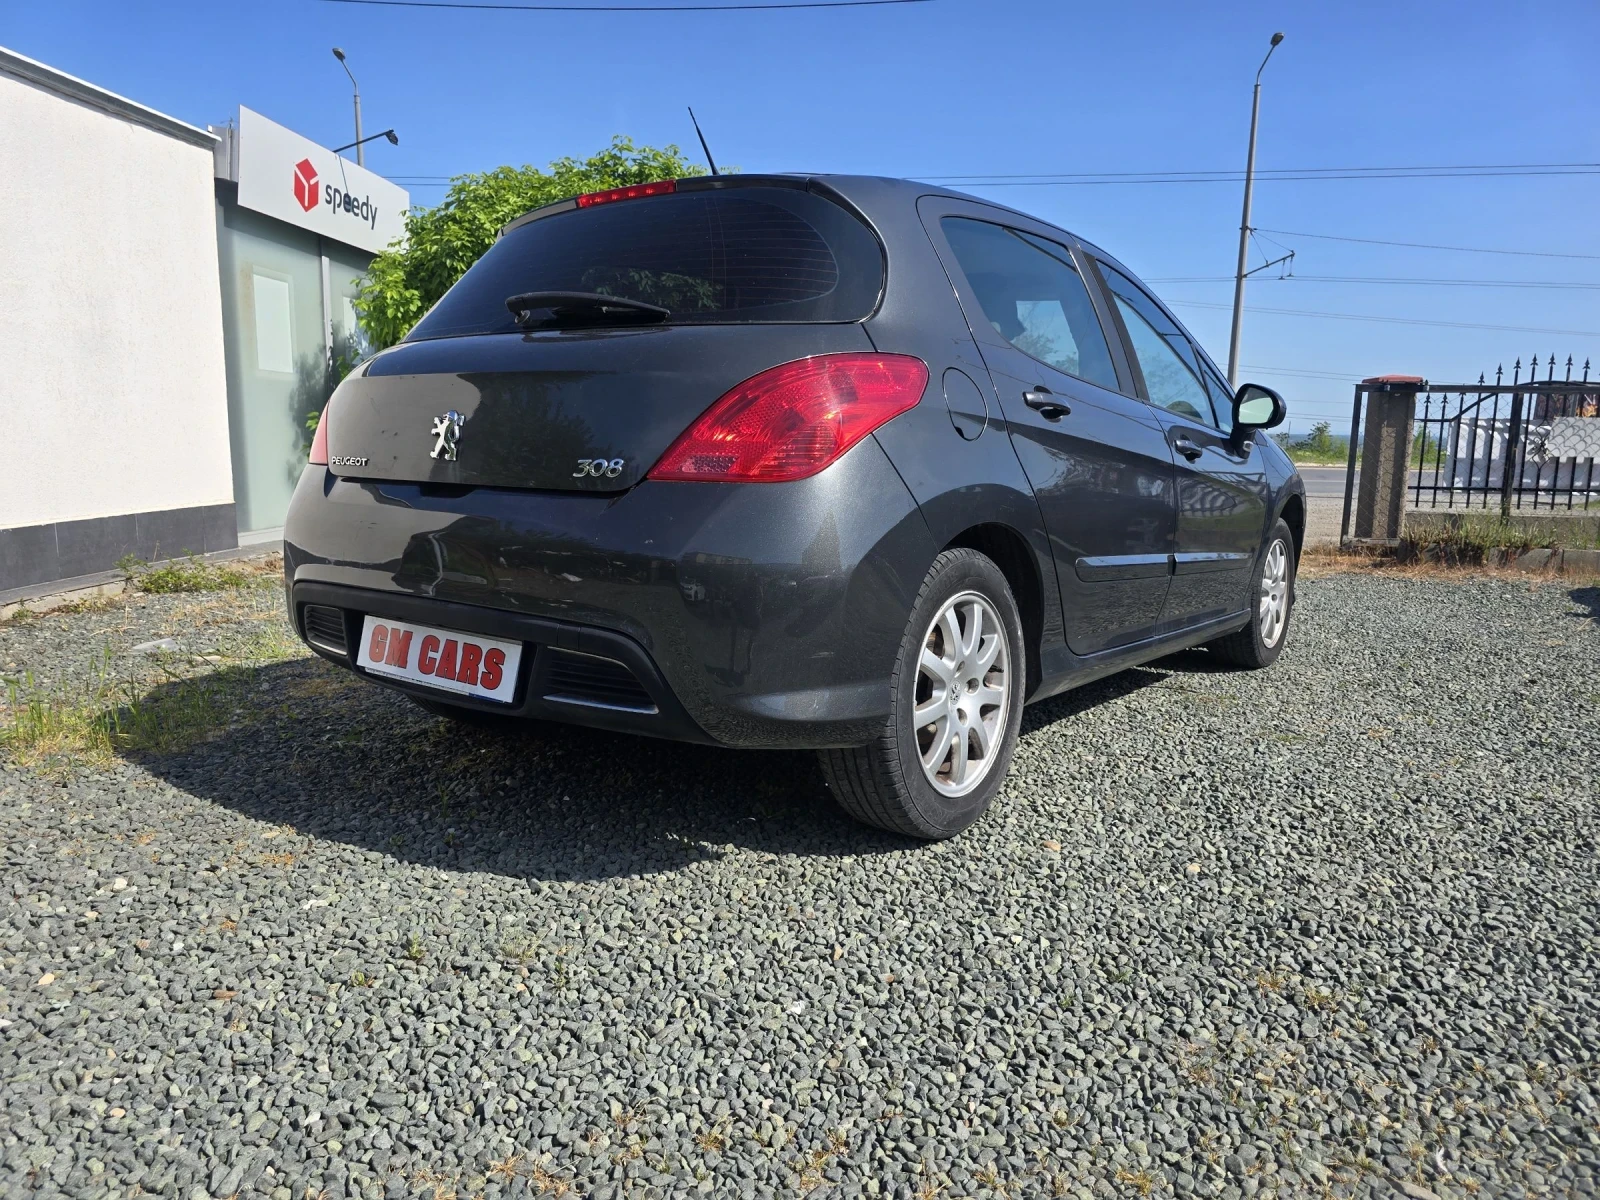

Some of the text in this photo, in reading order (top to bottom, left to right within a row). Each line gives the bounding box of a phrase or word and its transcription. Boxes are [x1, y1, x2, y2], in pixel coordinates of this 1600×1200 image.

[325, 184, 377, 230] speedy
[331, 456, 368, 466] PEUGEOT
[572, 458, 624, 477] 308
[368, 624, 413, 669] GM
[417, 634, 506, 690] CARS
